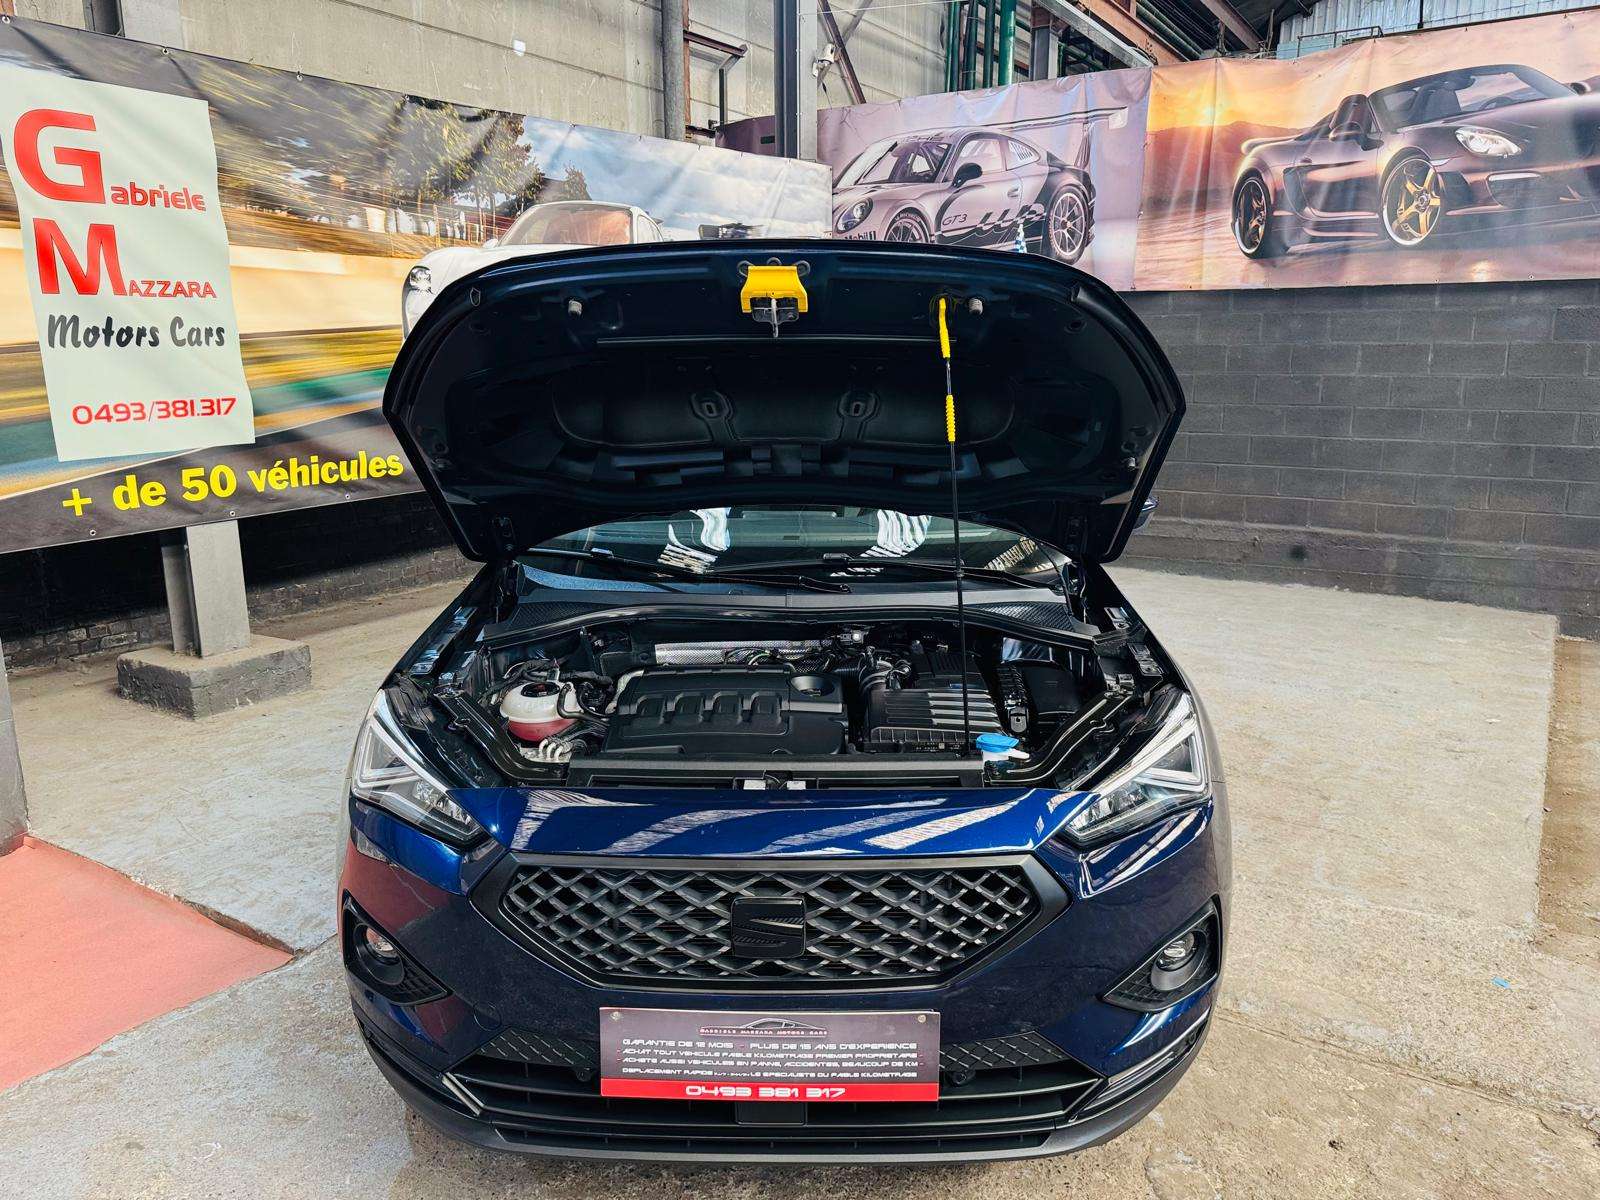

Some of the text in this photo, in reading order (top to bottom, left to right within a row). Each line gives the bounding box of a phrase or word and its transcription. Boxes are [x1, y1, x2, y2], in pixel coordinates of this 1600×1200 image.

[13, 108, 207, 212] Gabriele
[941, 213, 968, 226] GT3
[47, 313, 227, 348] Motors Cars
[71, 396, 238, 426] 0493/381.317
[62, 450, 405, 517] + de 50 véhicules
[622, 1039, 676, 1047] GARANTIE
[685, 1085, 846, 1098] 0493 381 317
